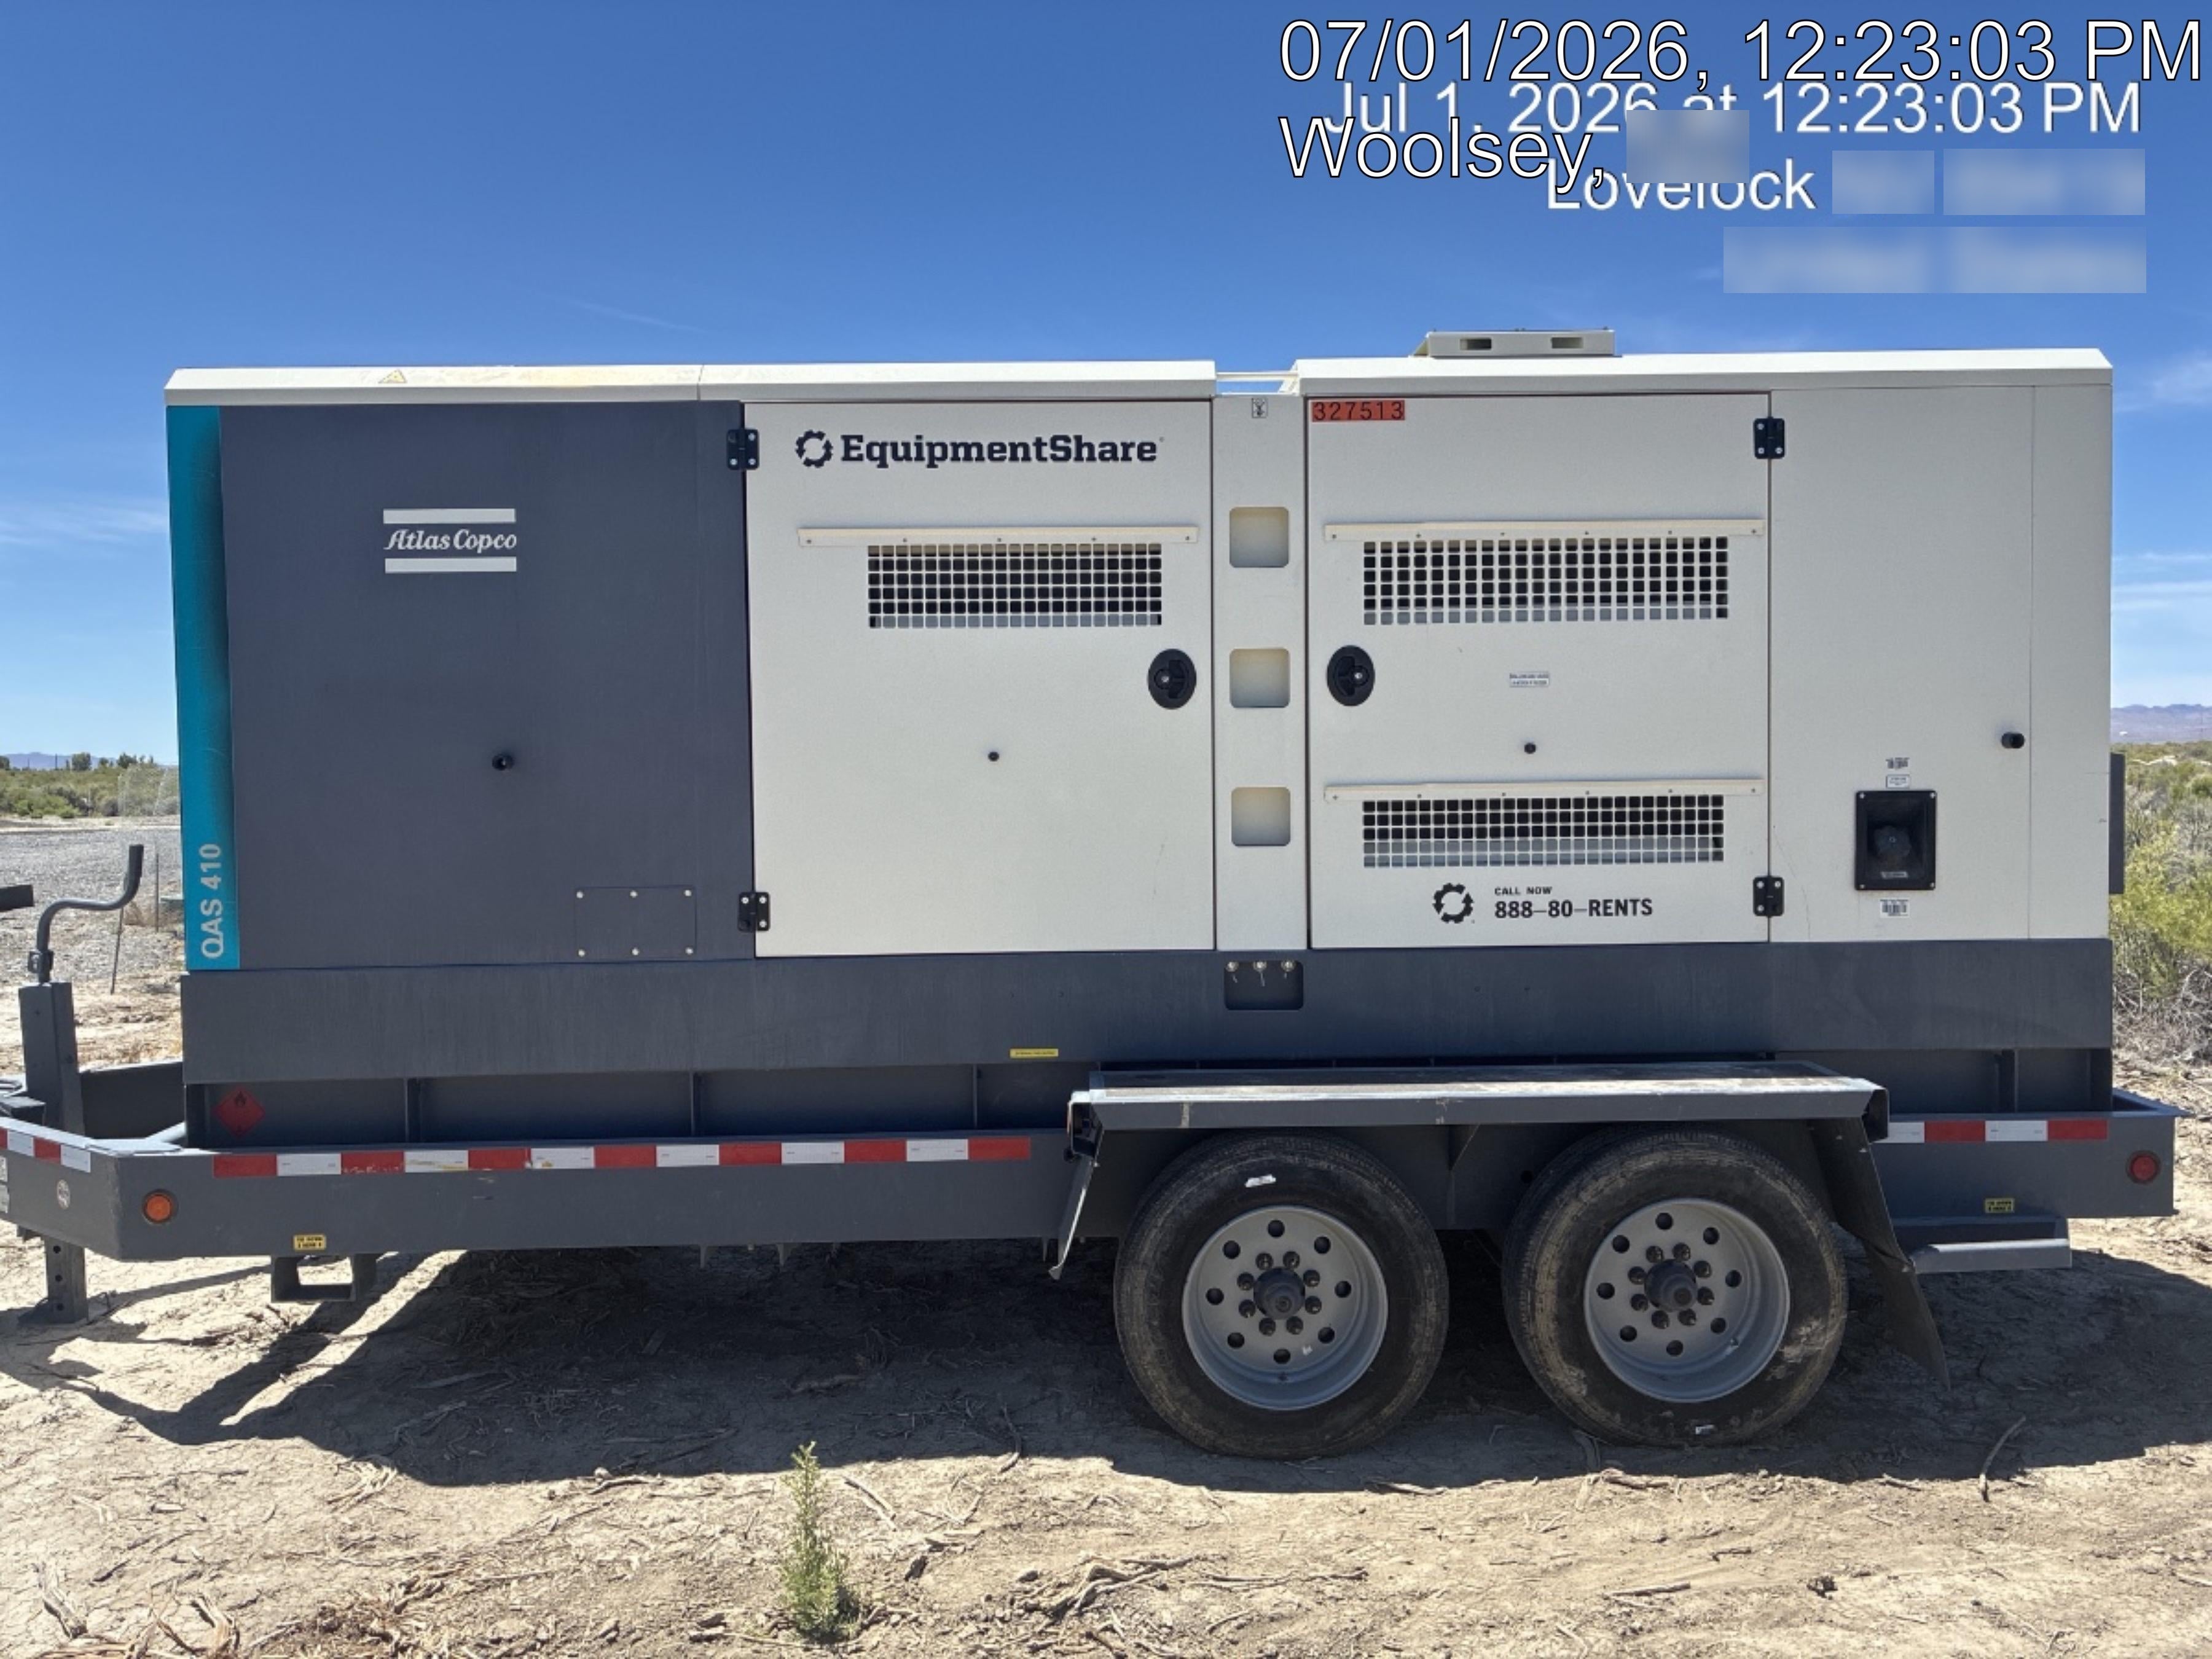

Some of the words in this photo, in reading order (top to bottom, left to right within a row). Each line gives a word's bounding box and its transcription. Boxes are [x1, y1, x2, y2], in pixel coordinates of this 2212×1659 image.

[1314, 401, 1403, 420] 327513
[841, 434, 1157, 468] EquipmentShare
[383, 528, 450, 550] Atlas
[453, 528, 517, 554] Copco
[198, 844, 222, 889] 410
[1494, 887, 1521, 896] CALL
[1526, 886, 1553, 895] NOW
[200, 898, 224, 959] QAS
